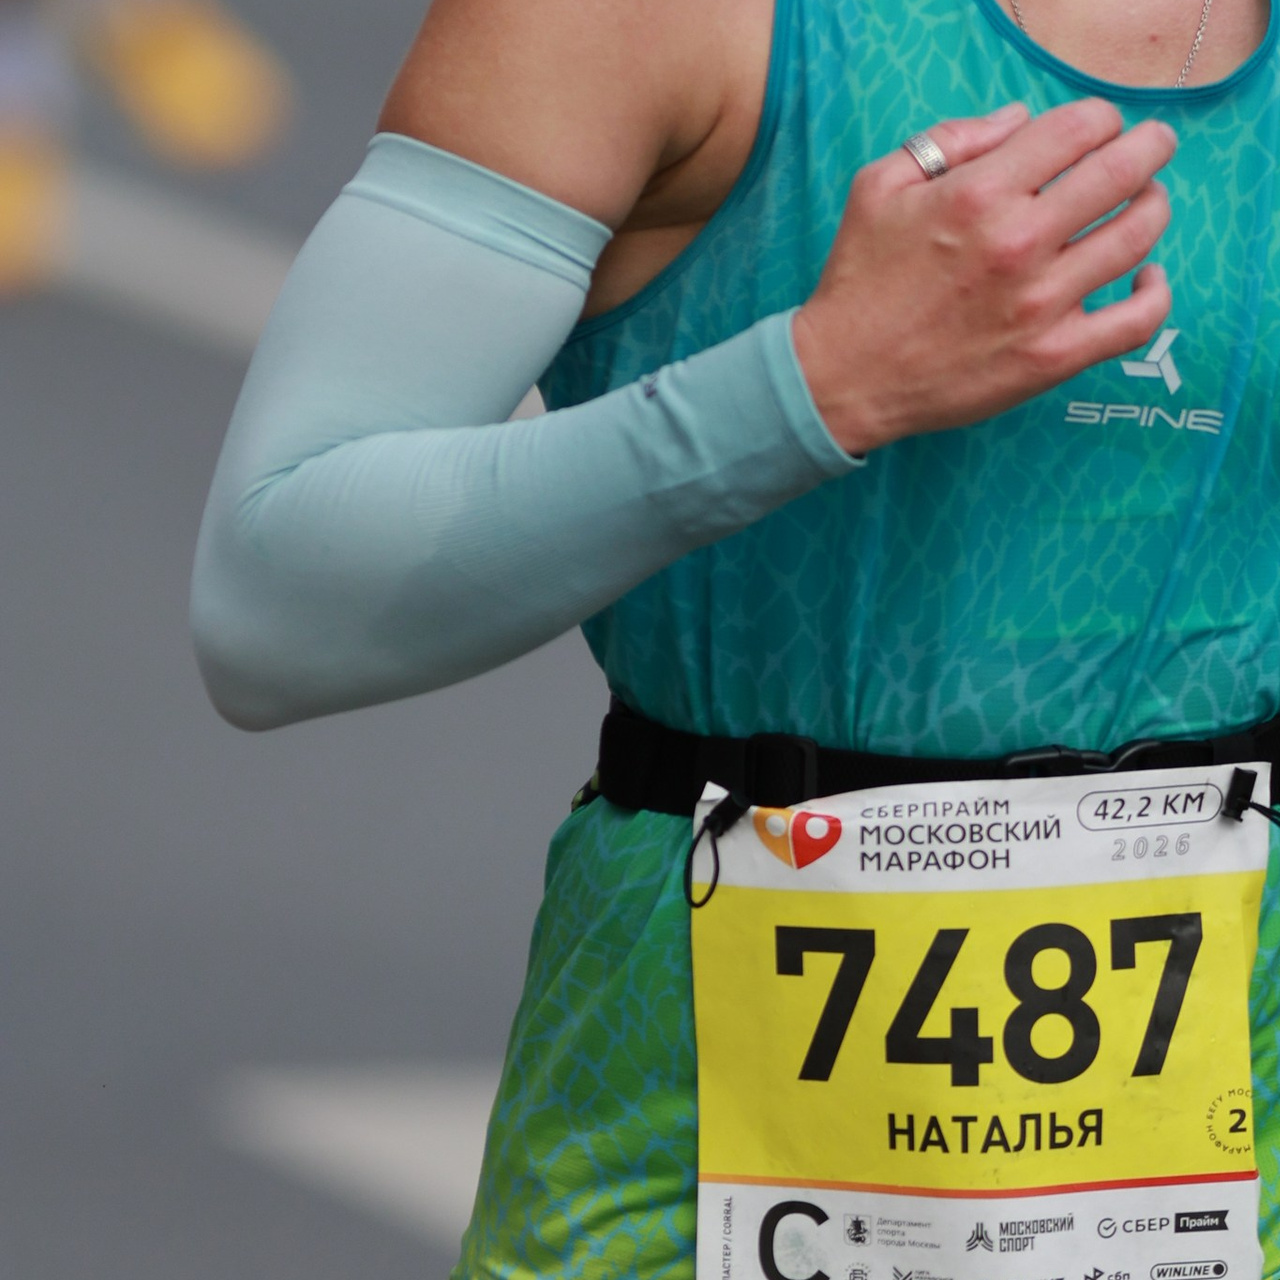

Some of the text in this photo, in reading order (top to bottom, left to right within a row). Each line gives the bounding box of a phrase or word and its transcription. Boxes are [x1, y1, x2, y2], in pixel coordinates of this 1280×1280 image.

[1064, 401, 1224, 435] SPINE
[860, 797, 1010, 819] СБЕРПРАЙМ
[1094, 792, 1205, 821] 42,2 КМ
[860, 814, 1061, 846] МОСКОВСКИЙ
[860, 849, 1010, 871] МАРАФОН
[1111, 833, 1190, 861] 2026
[775, 912, 1204, 1087] 7487
[888, 1108, 1104, 1155] НАТАЛЬЯ
[1229, 1108, 1247, 1133] 2
[723, 1196, 732, 1235] CORRAL
[999, 1212, 1074, 1237] МОСКОВСКИЙ
[1122, 1215, 1219, 1233] СБЕР Прайм
[999, 1236, 1035, 1252] СПОРТ
[1156, 1265, 1211, 1278] WINLINE
